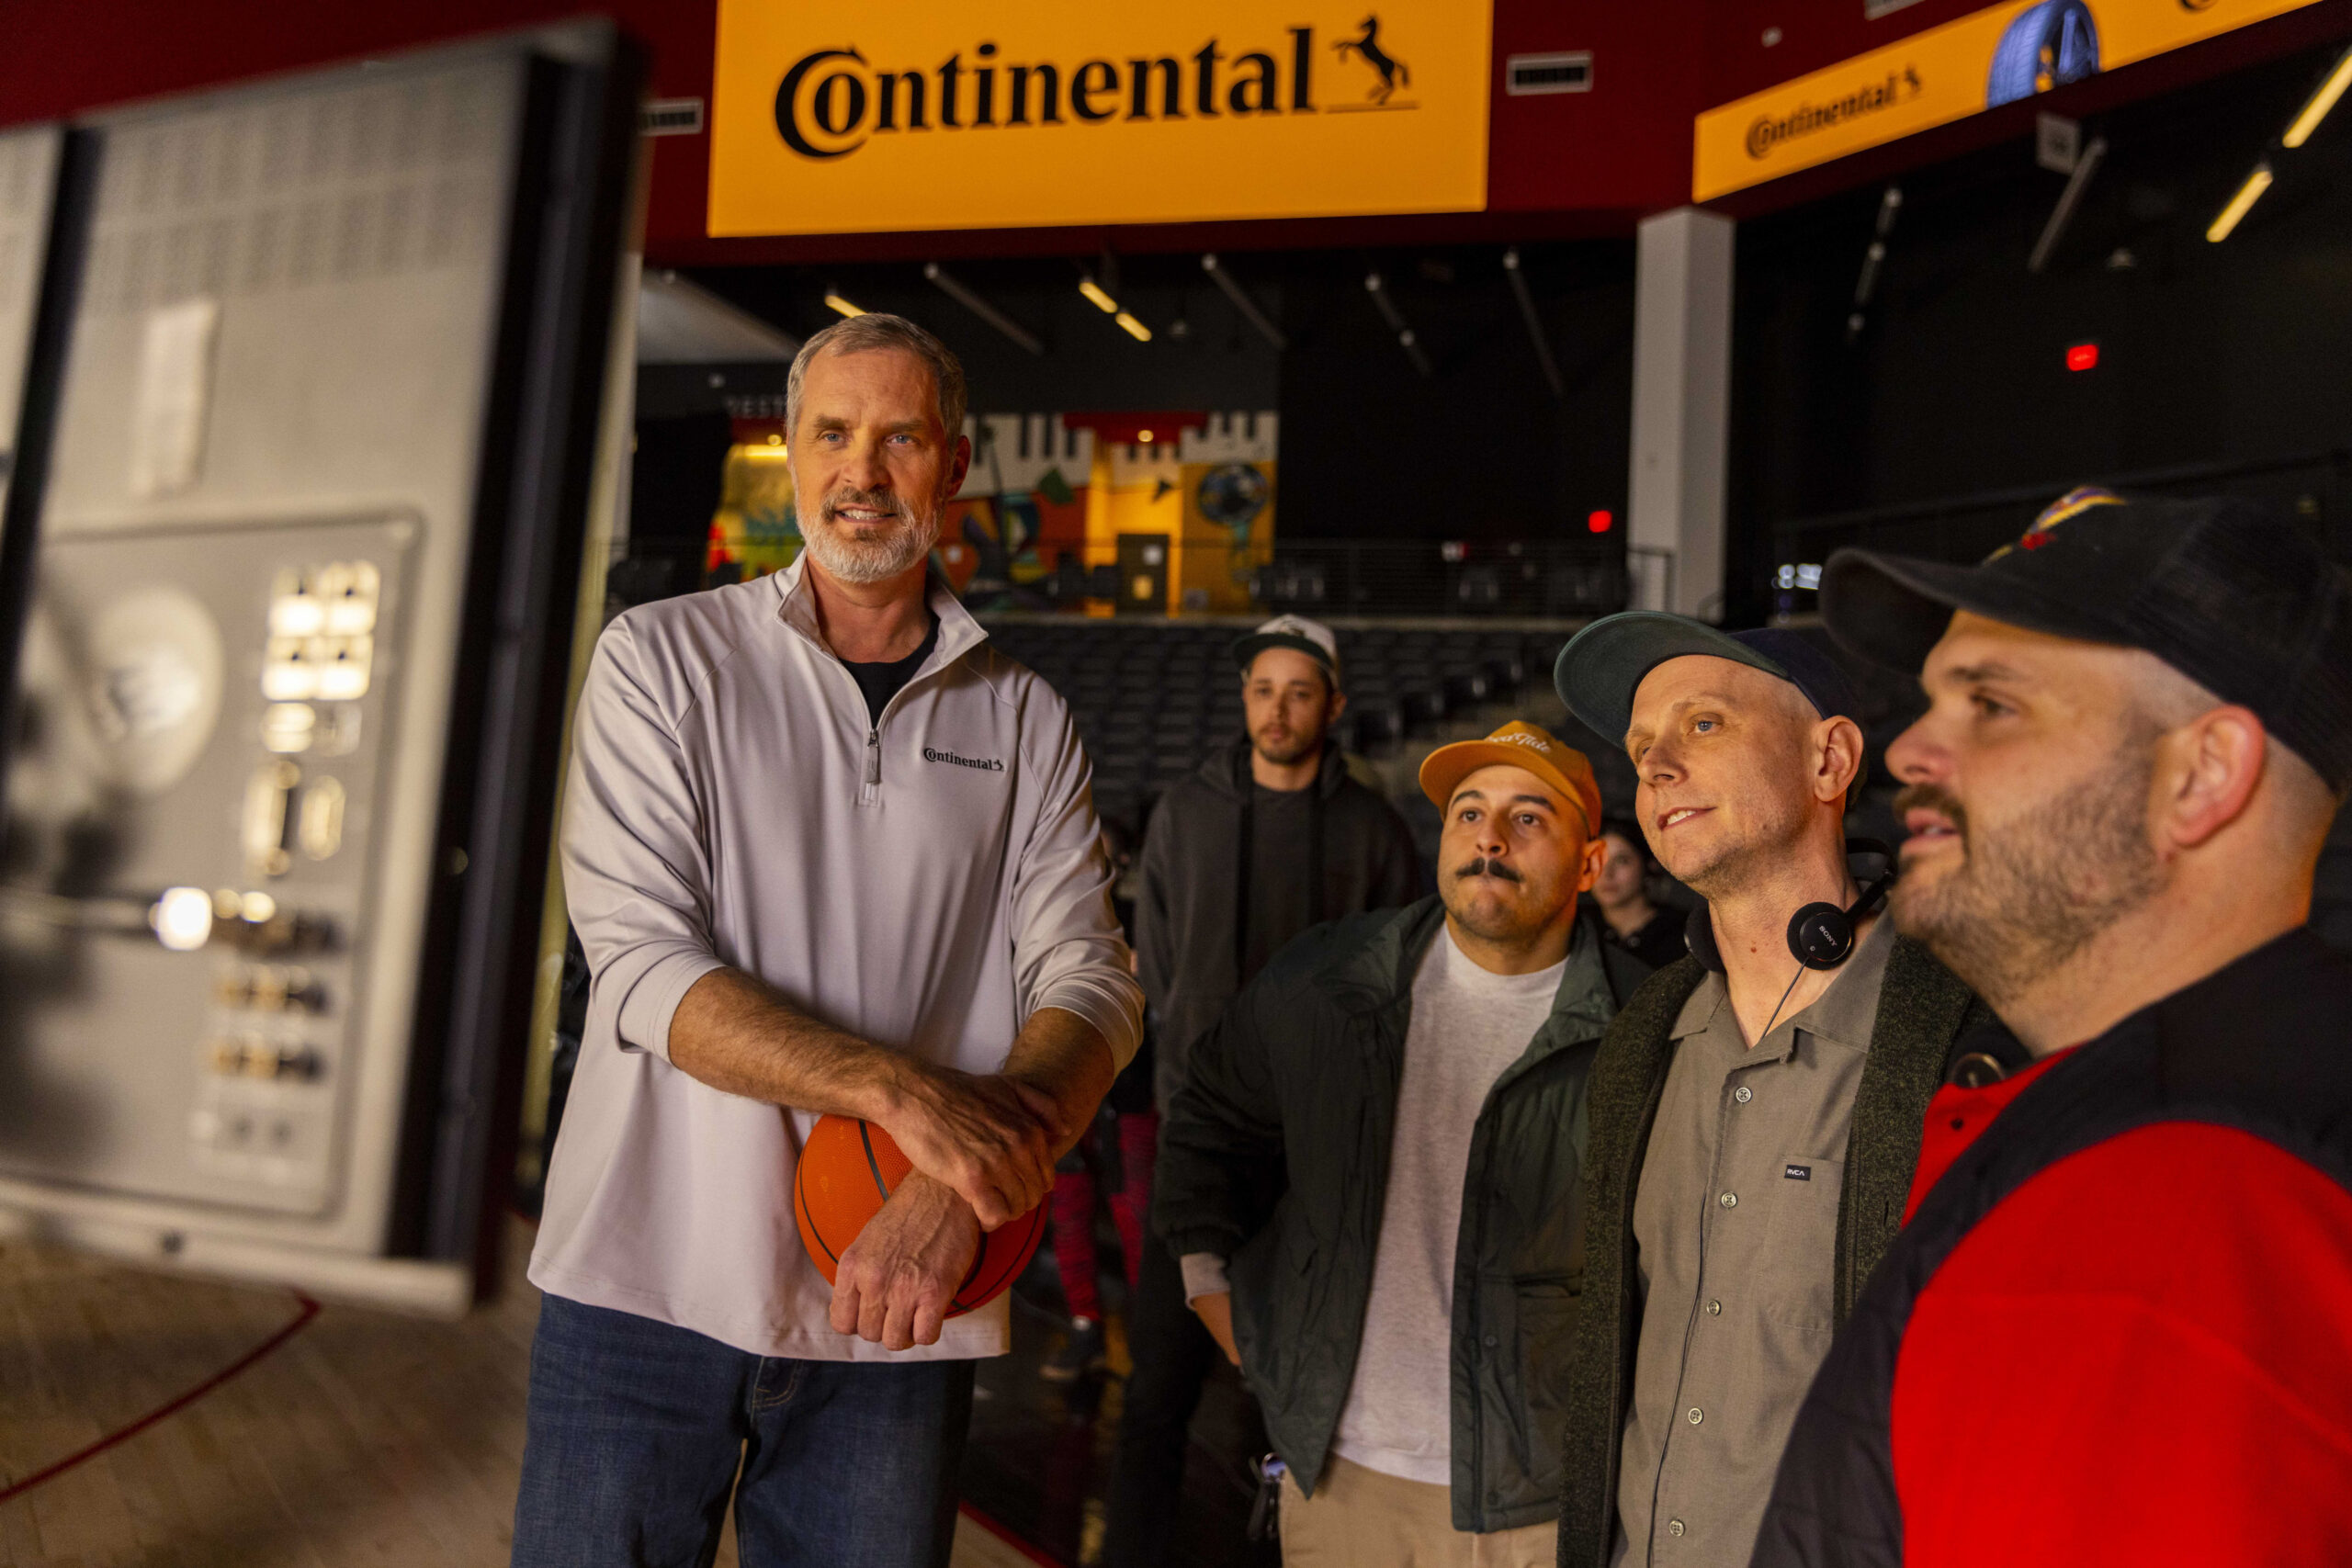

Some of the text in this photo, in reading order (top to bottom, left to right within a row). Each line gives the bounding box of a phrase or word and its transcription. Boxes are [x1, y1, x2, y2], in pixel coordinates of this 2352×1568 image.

[774, 25, 1317, 161] Continental
[1747, 70, 1897, 158] Continental
[923, 747, 992, 770] Continental
[1819, 925, 1838, 947] SONY
[1787, 1168, 1805, 1177] RVCA
